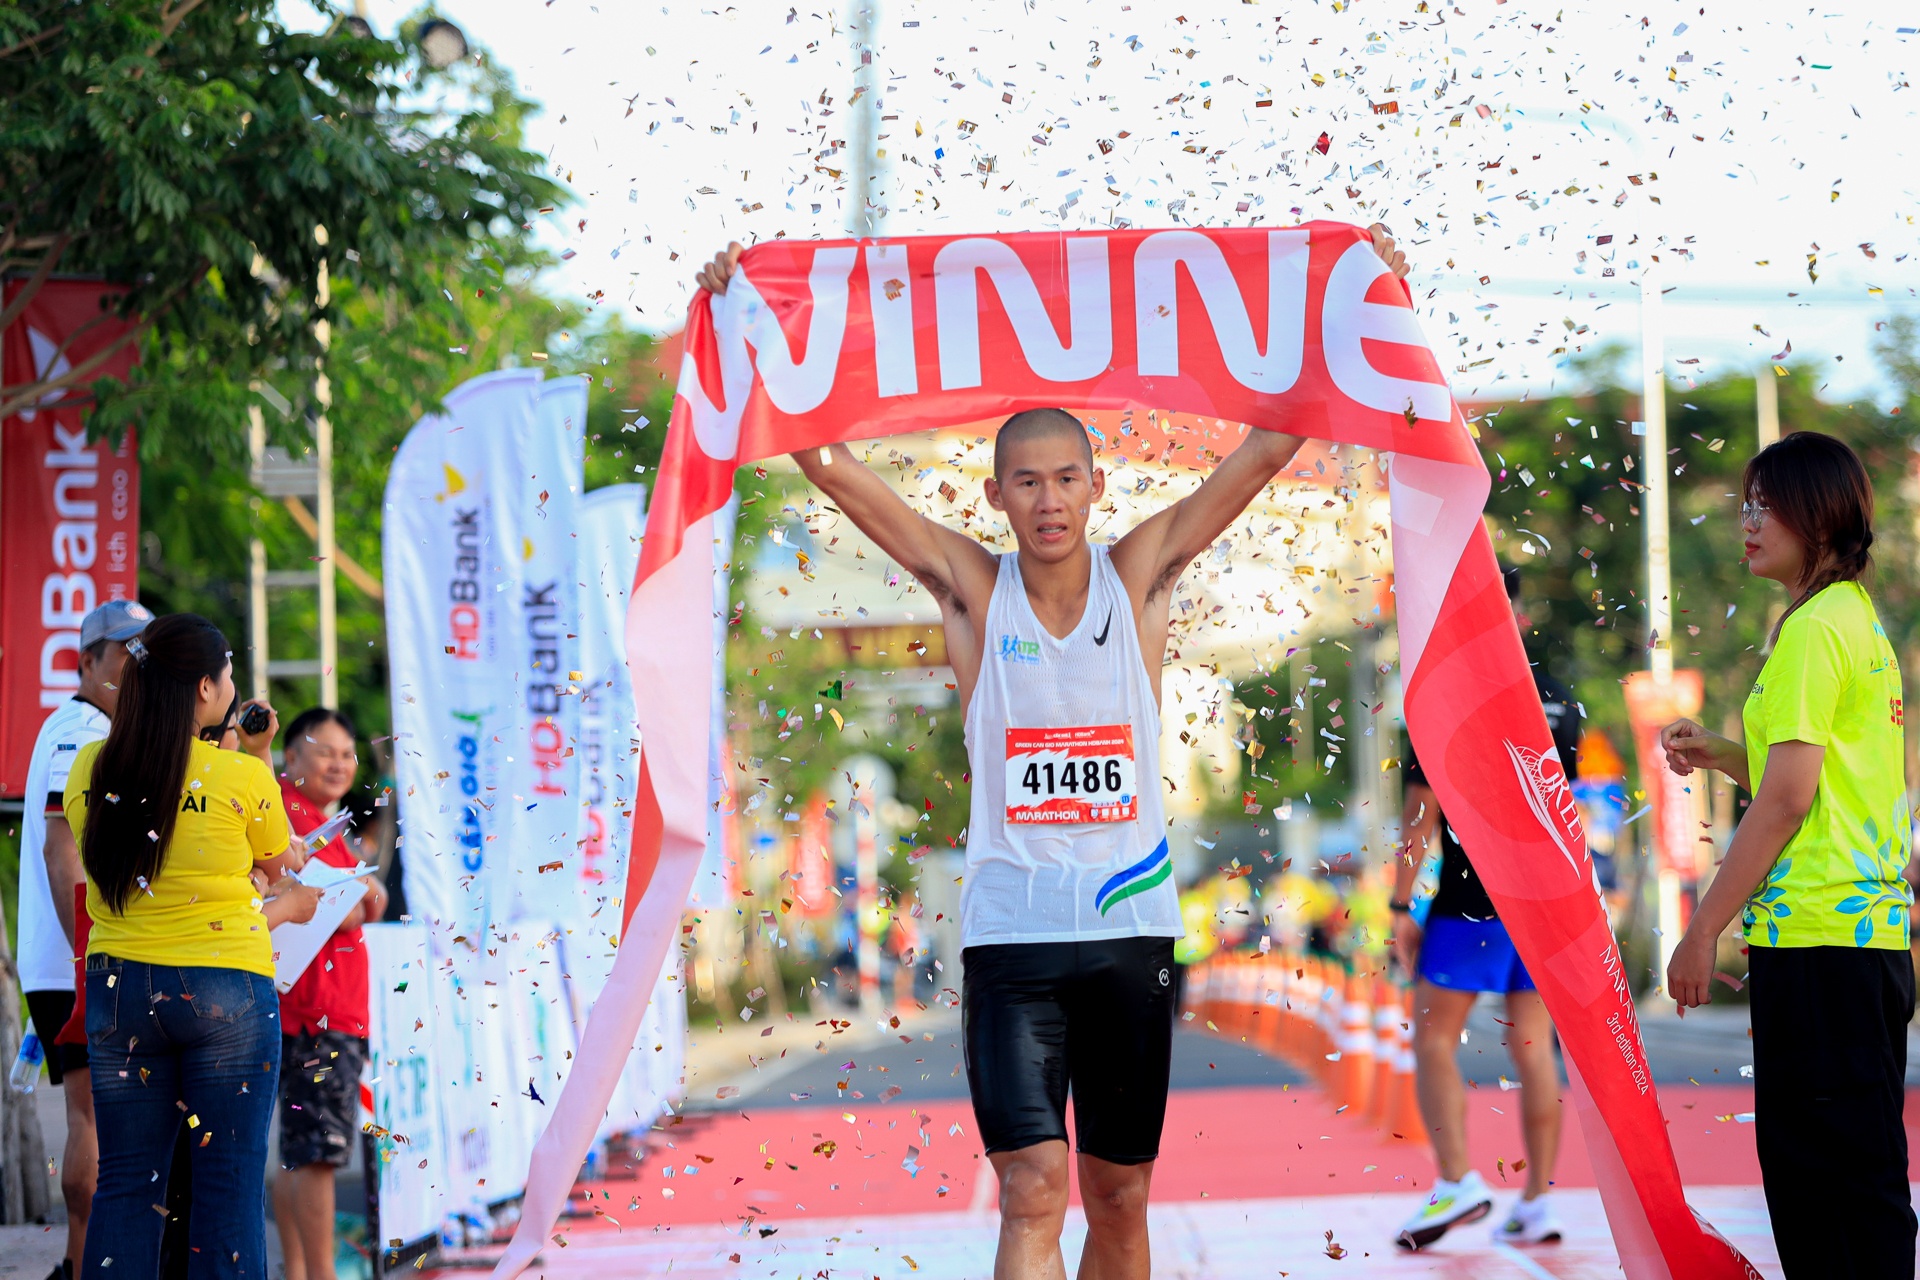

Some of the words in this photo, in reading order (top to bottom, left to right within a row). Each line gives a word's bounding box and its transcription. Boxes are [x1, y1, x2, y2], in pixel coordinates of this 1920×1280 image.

[451, 507, 480, 660] HDBank
[524, 580, 565, 794] HDBank
[1055, 740, 1087, 748] MARATHON
[1022, 759, 1122, 795] 41486
[1016, 811, 1080, 820] MARATHON
[1606, 1012, 1624, 1035] 3rd
[1615, 1032, 1637, 1070] edition
[1631, 1065, 1650, 1096] 2024
